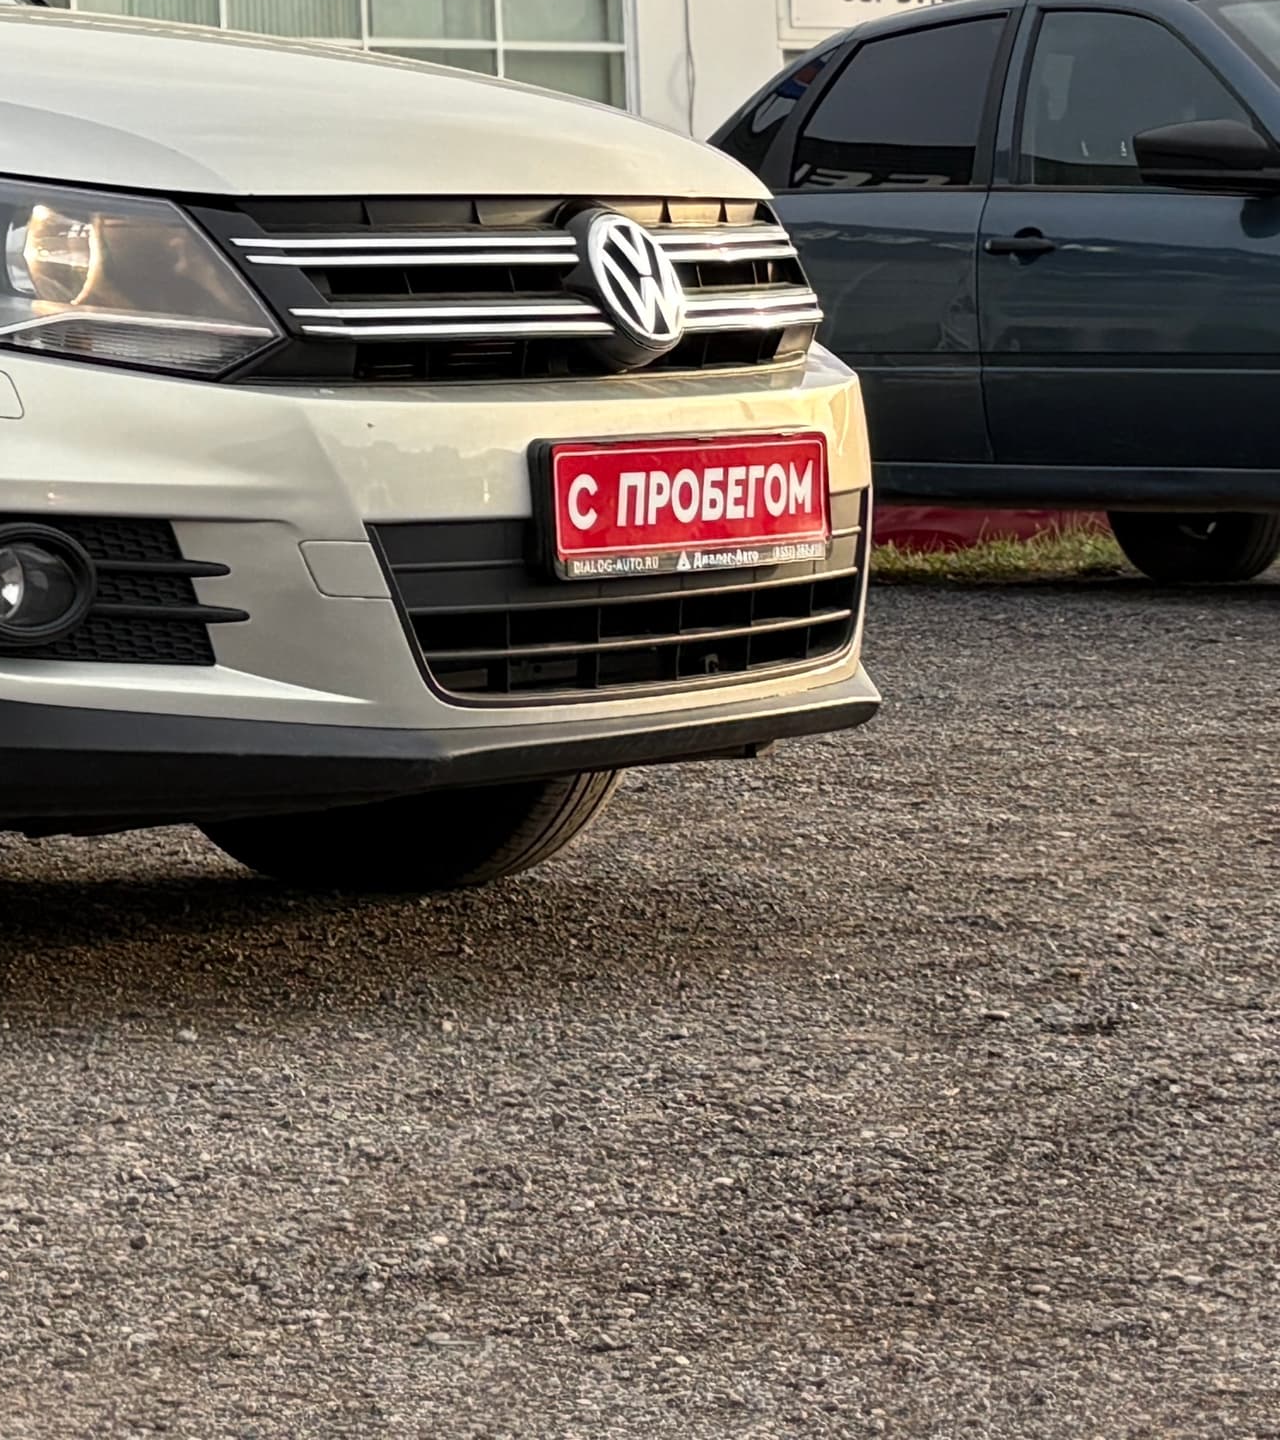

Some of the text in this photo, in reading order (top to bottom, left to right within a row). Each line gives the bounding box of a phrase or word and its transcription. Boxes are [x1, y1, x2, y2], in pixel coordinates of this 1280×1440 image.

[568, 460, 813, 530] С ПРОБЕГОМ
[573, 556, 659, 574] DIALOG-AUTO.RU
